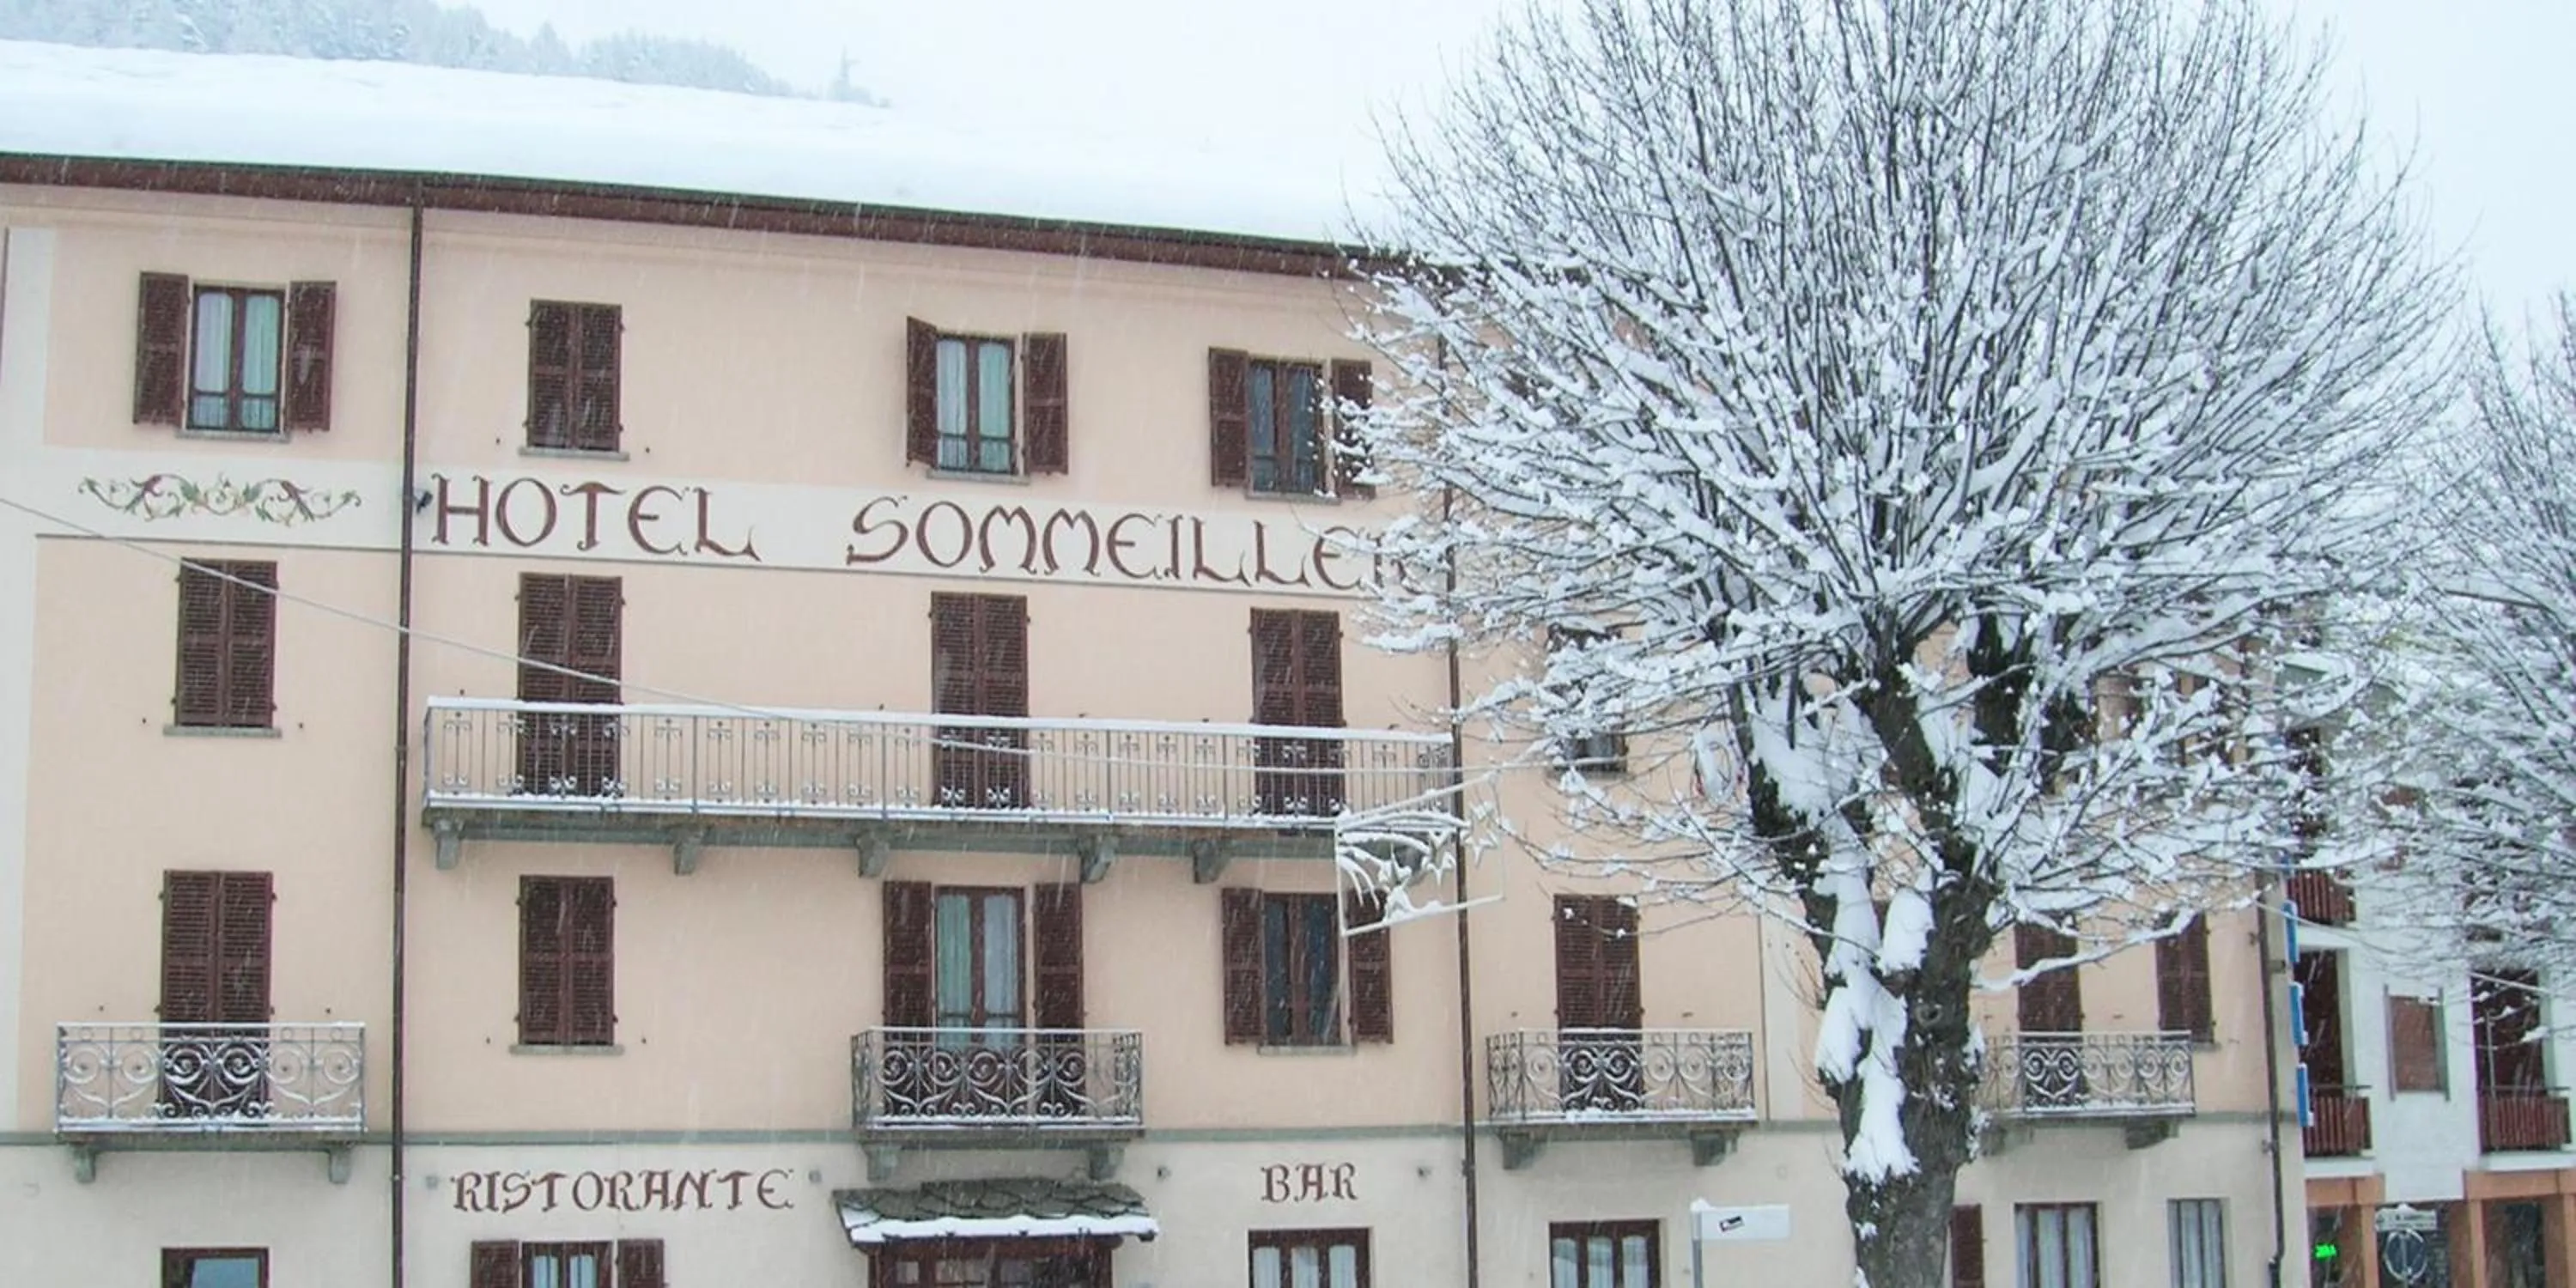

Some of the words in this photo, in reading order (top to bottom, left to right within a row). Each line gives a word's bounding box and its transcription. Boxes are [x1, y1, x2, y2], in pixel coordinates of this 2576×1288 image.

[431, 473, 761, 562] HOTEL
[451, 1170, 795, 1213] RISTORANTE
[1261, 1162, 1358, 1203] BAR
